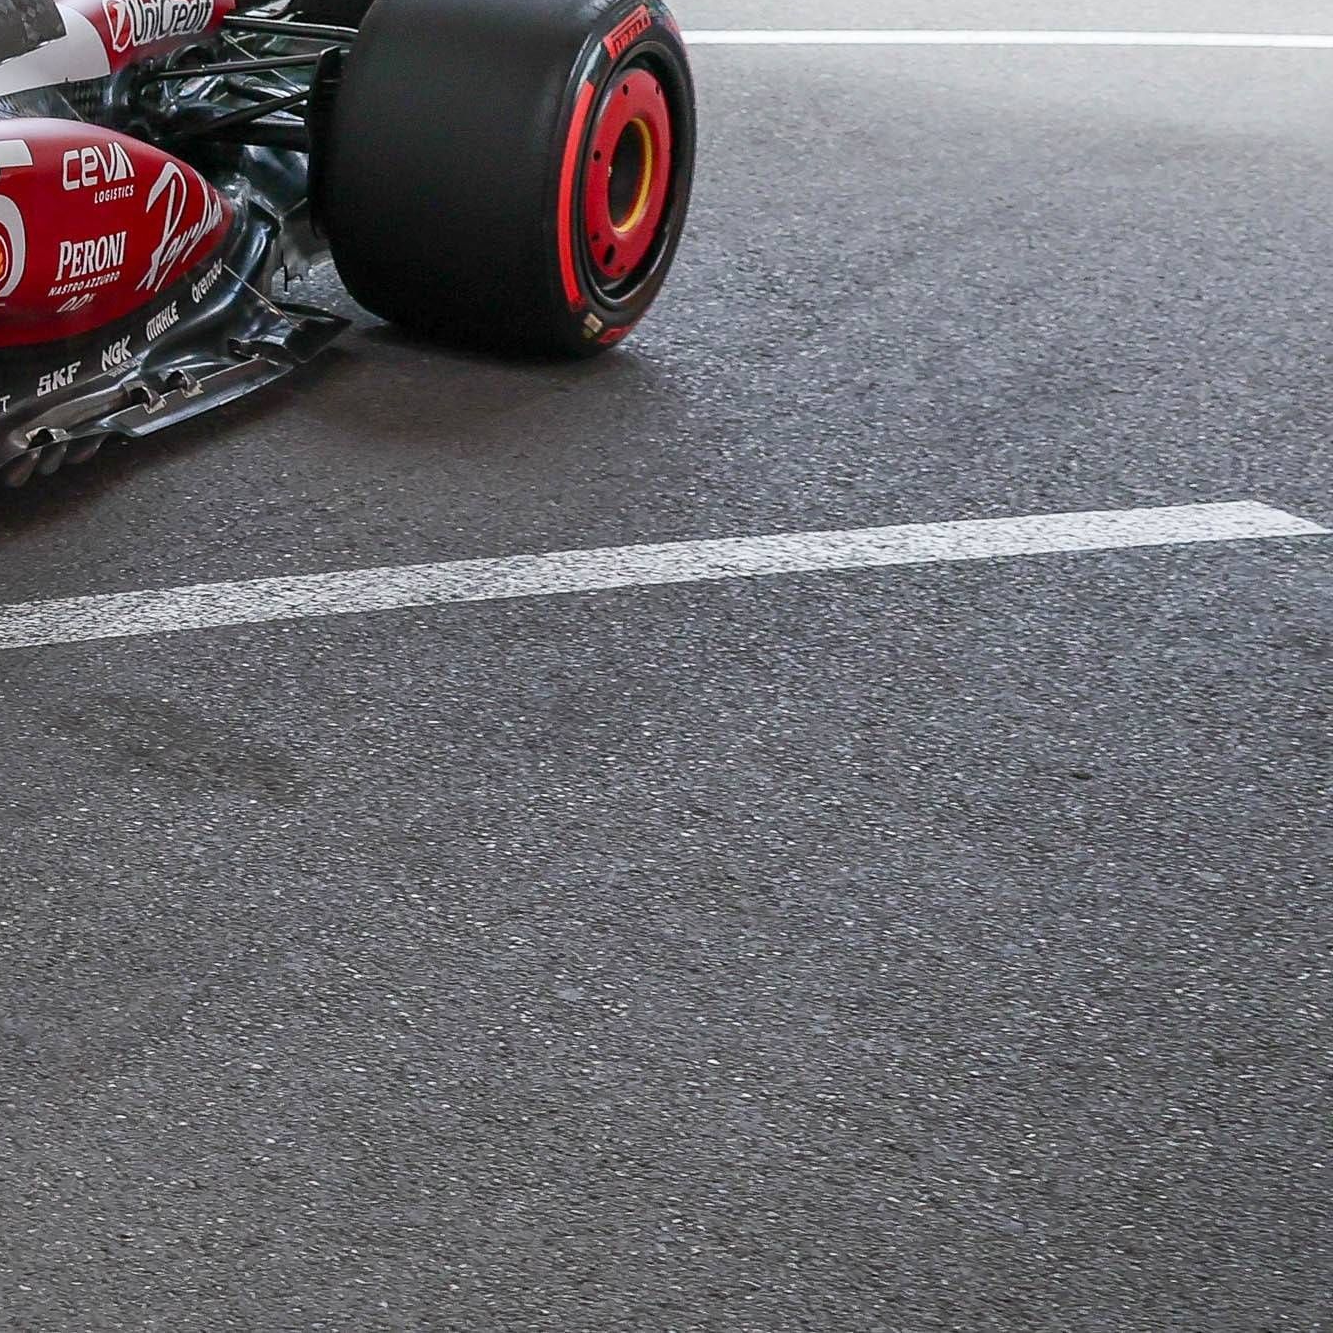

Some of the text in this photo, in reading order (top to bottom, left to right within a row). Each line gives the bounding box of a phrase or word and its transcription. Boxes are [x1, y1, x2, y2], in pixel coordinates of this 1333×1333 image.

[94, 184, 134, 204] LOGISTICS
[55, 231, 127, 281] PERONI
[48, 271, 121, 296] NASTRO AZZURRO
[145, 300, 180, 342] MAHLE
[101, 335, 134, 371] NGK
[36, 361, 82, 397] SKF
